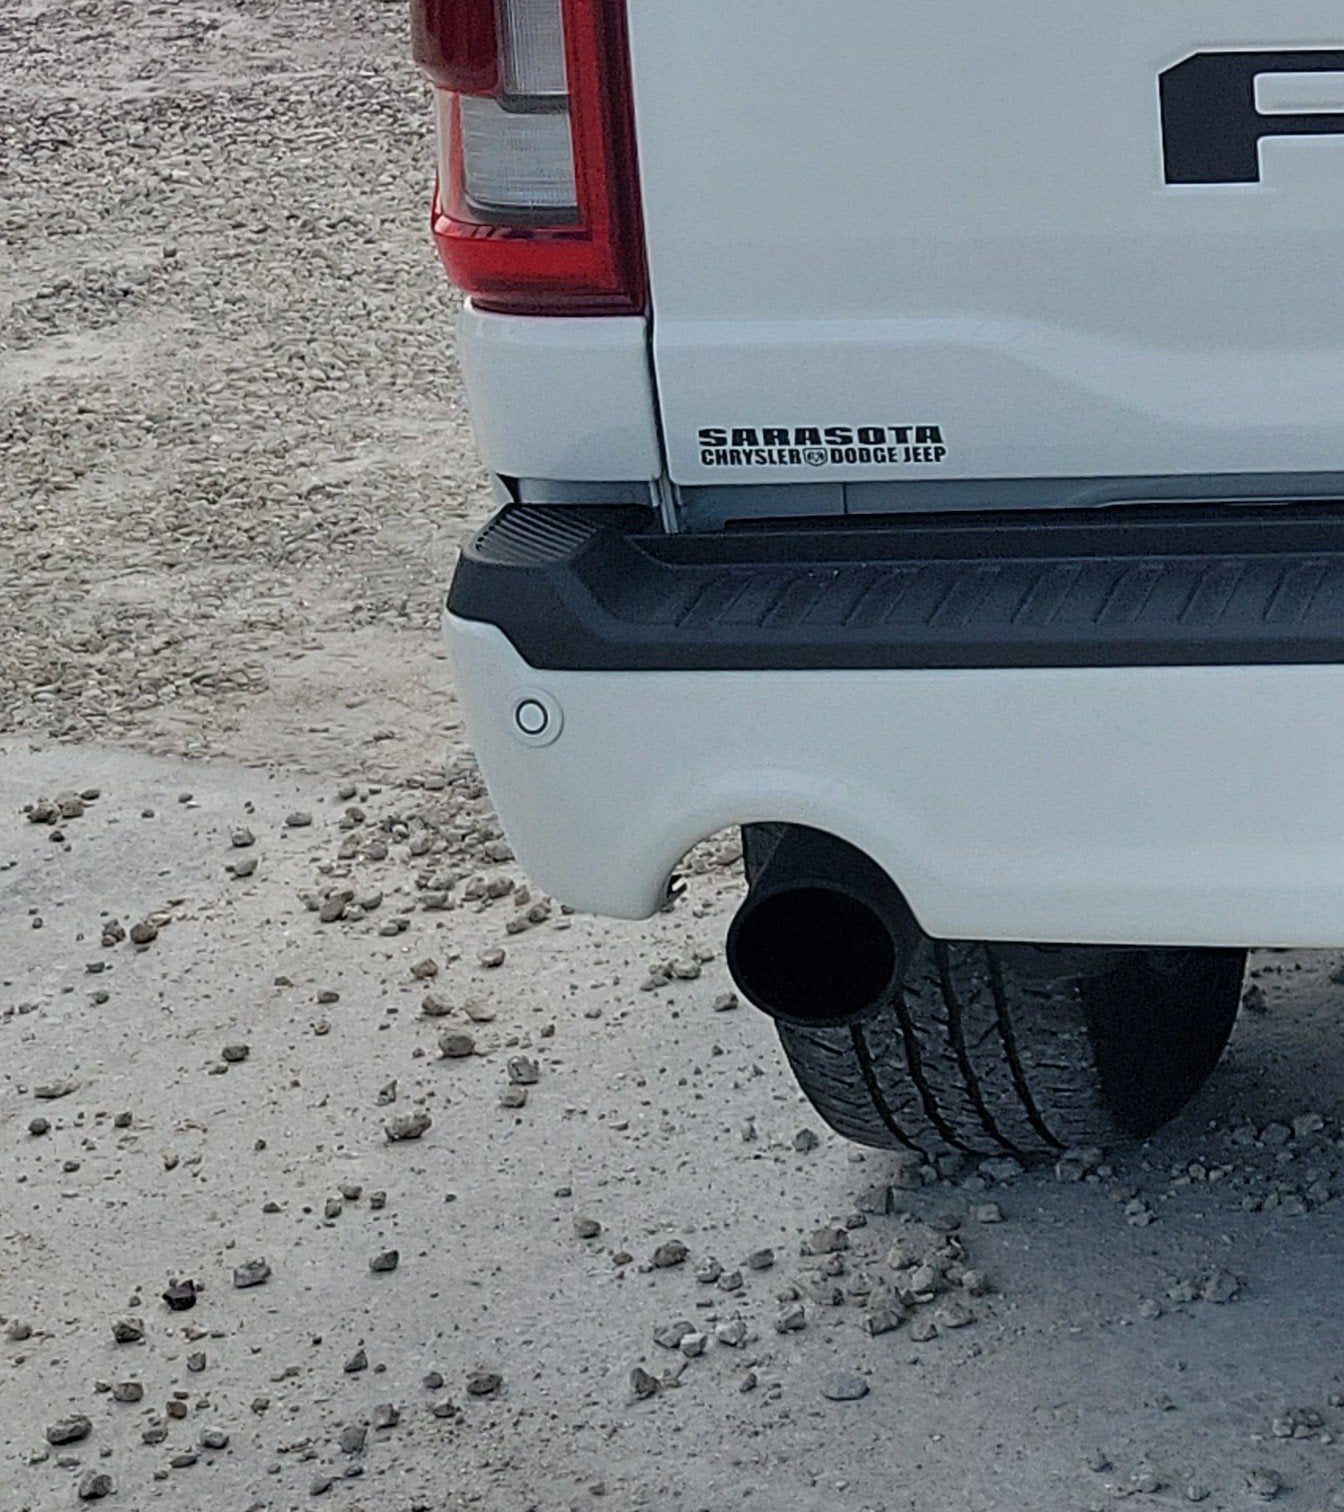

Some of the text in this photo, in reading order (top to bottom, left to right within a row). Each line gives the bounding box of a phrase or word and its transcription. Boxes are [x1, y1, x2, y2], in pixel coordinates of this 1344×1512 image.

[698, 425, 944, 447] SARASOTA
[701, 445, 946, 466] CHRYSLER DODGE JEEP
